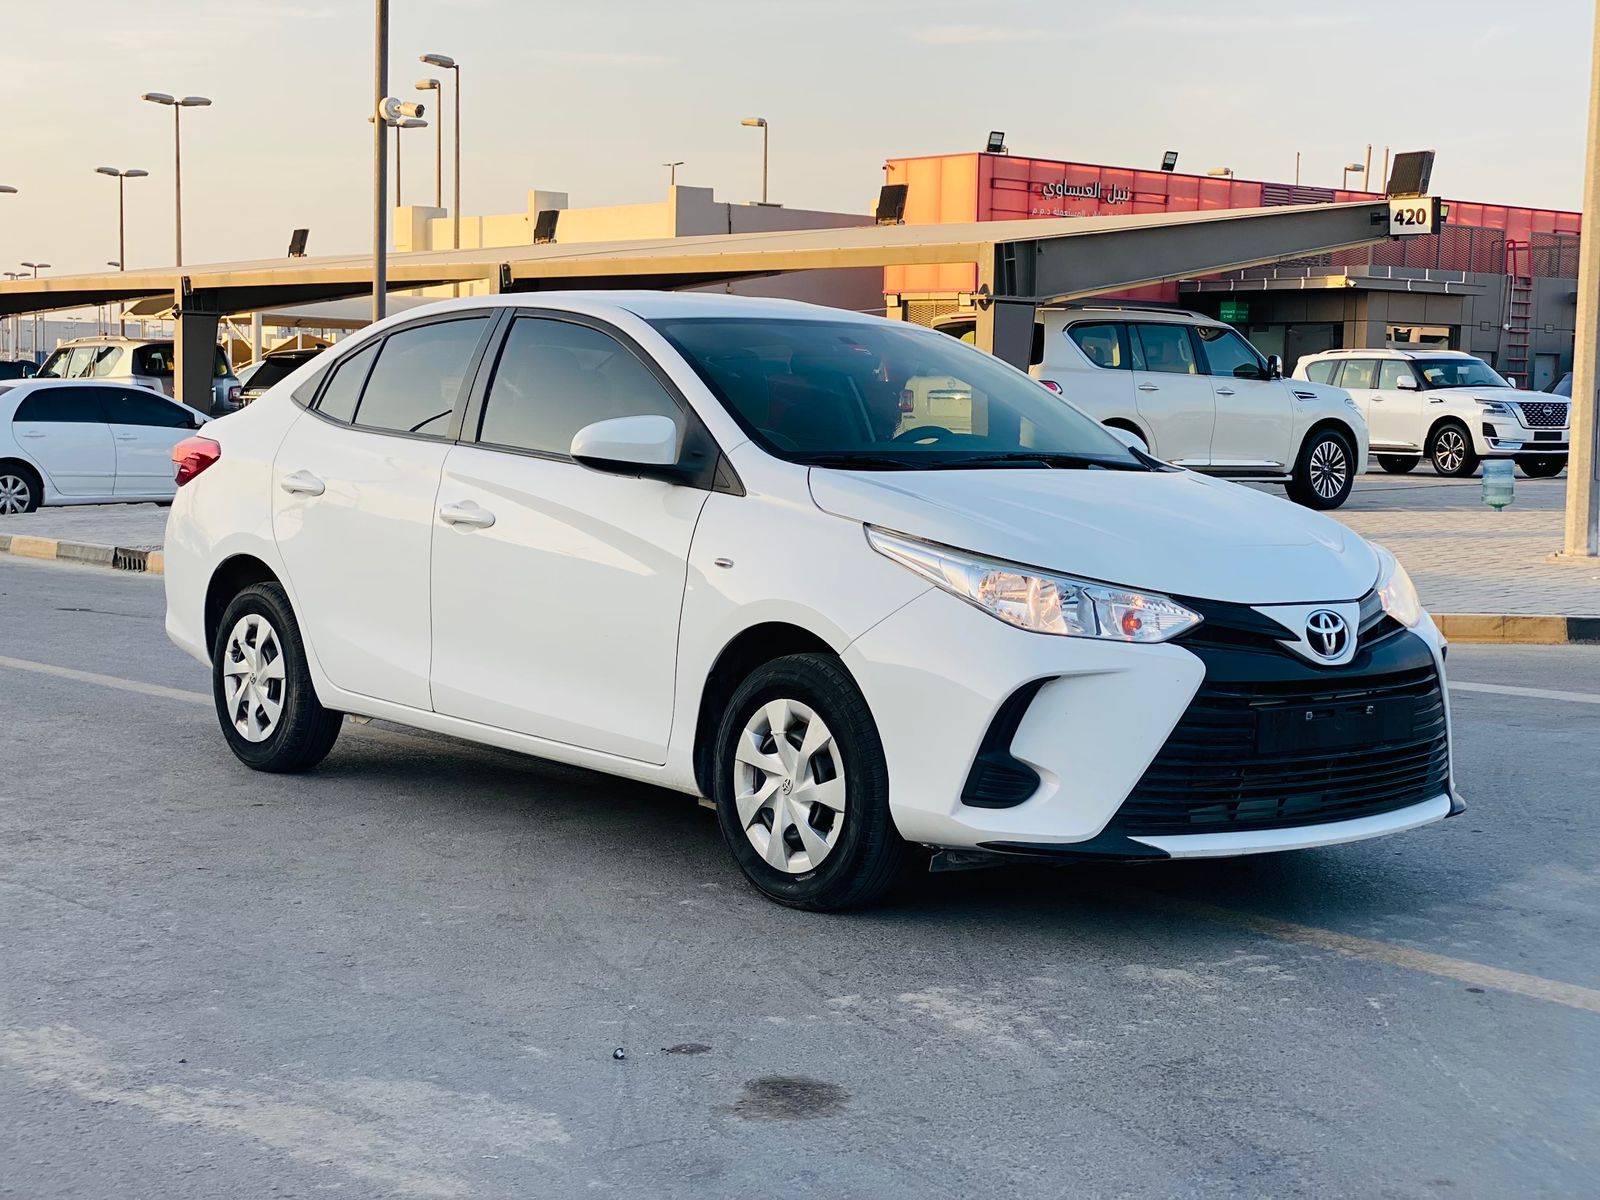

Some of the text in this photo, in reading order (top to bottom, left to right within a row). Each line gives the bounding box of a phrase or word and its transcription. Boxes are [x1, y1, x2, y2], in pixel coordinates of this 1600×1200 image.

[1043, 178, 1130, 204] نبيل العيساوي
[1394, 208, 1426, 226] 420
